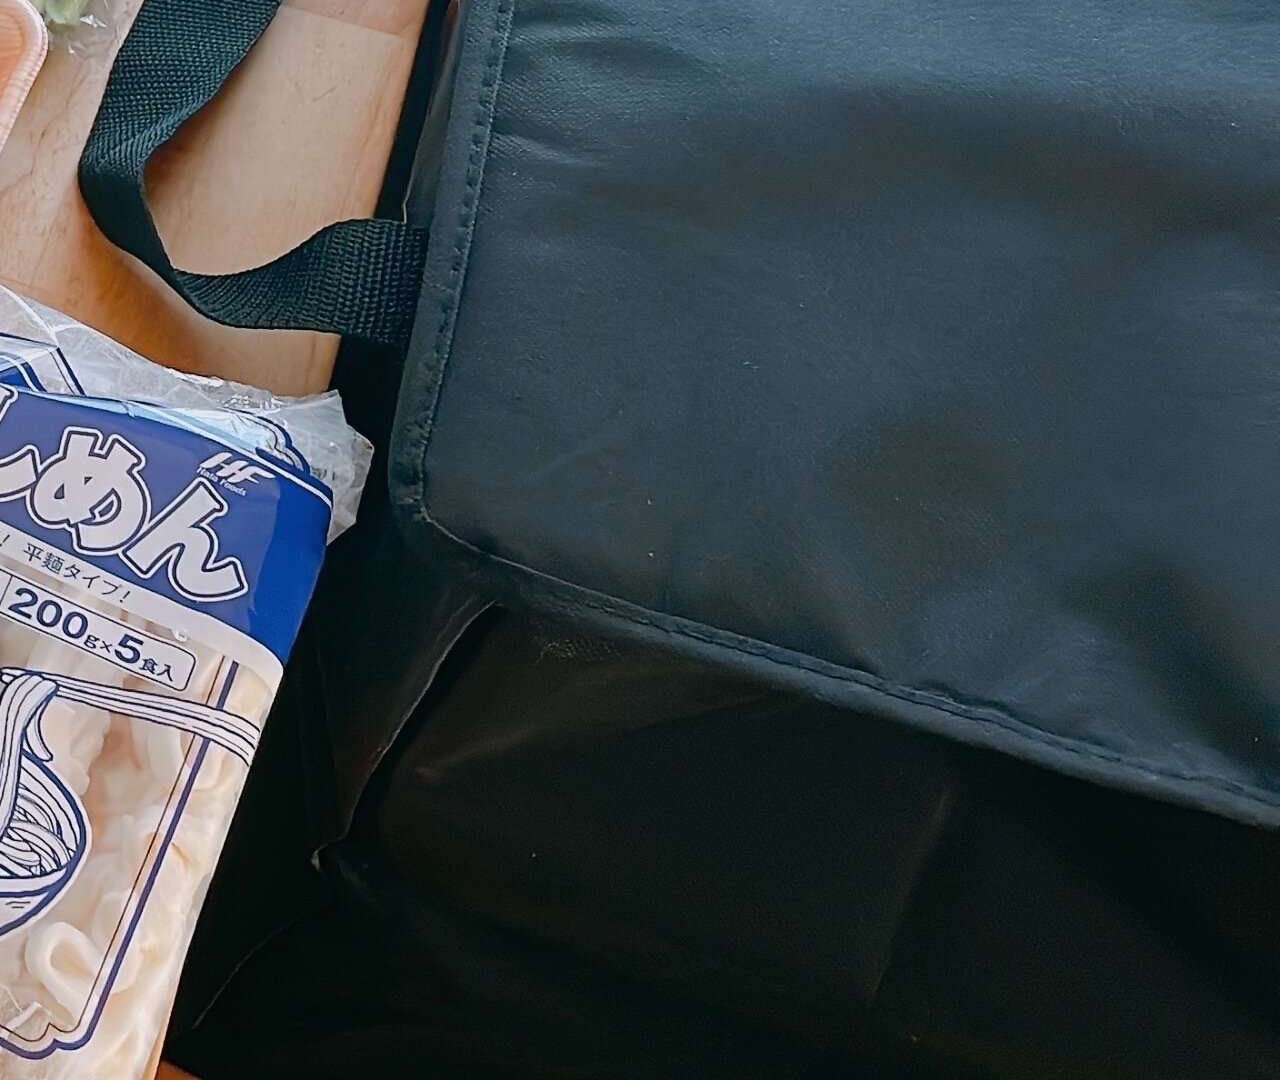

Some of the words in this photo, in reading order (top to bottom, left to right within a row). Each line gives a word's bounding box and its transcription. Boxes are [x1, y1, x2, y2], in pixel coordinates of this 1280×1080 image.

[23, 542, 132, 604] 平麺タイプ!
